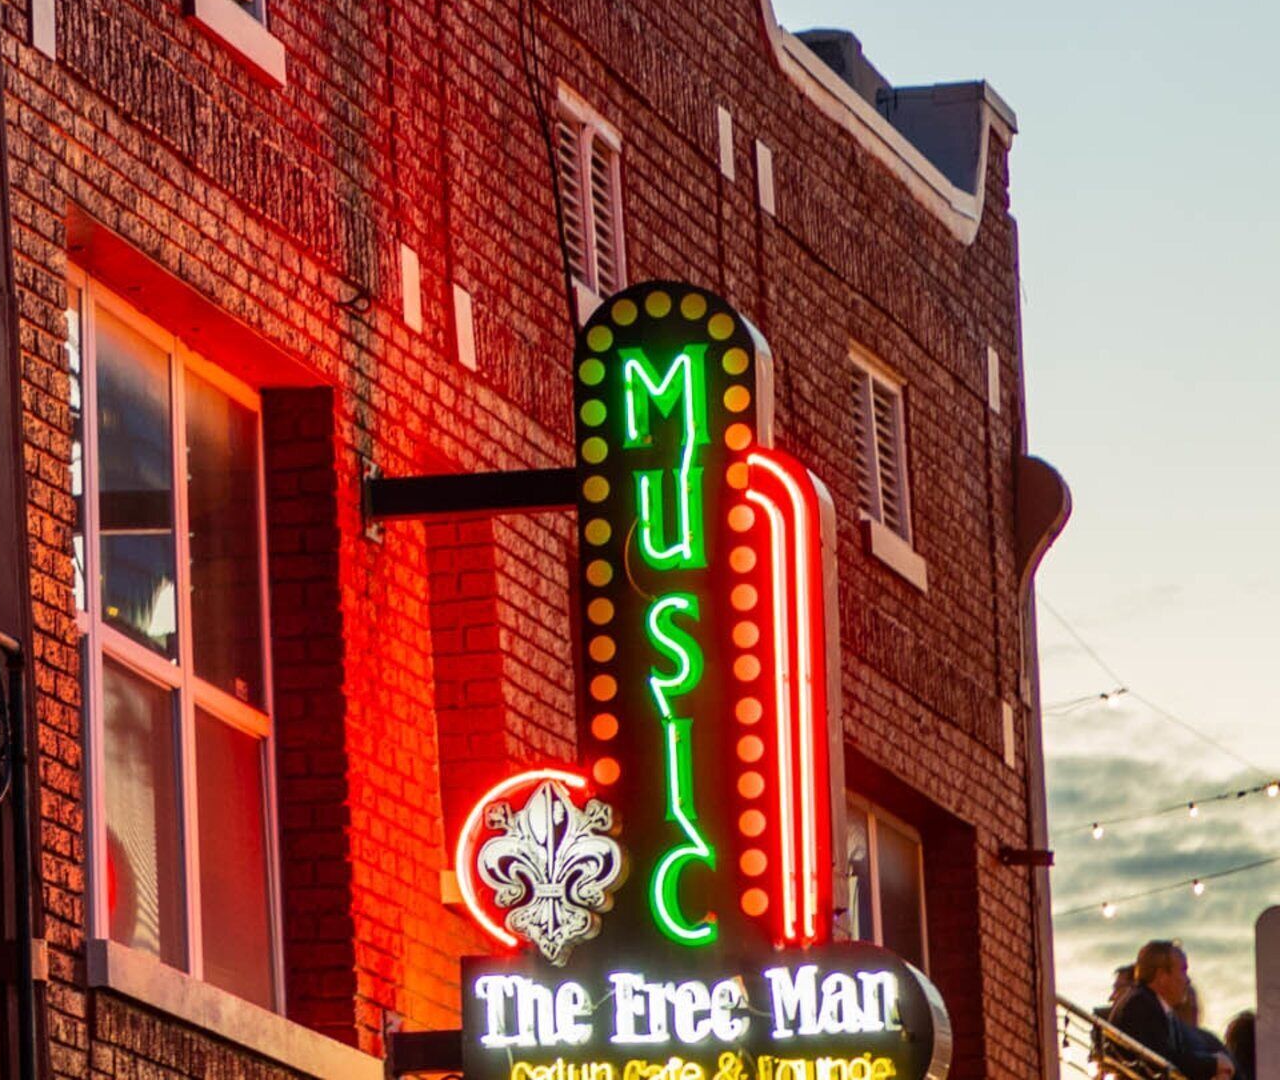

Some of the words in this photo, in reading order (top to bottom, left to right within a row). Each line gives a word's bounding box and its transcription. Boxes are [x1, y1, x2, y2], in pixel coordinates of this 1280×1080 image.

[620, 341, 717, 948] MUSIC
[475, 974, 593, 1047] The
[609, 971, 750, 1043] Free
[763, 964, 901, 1039] Man
